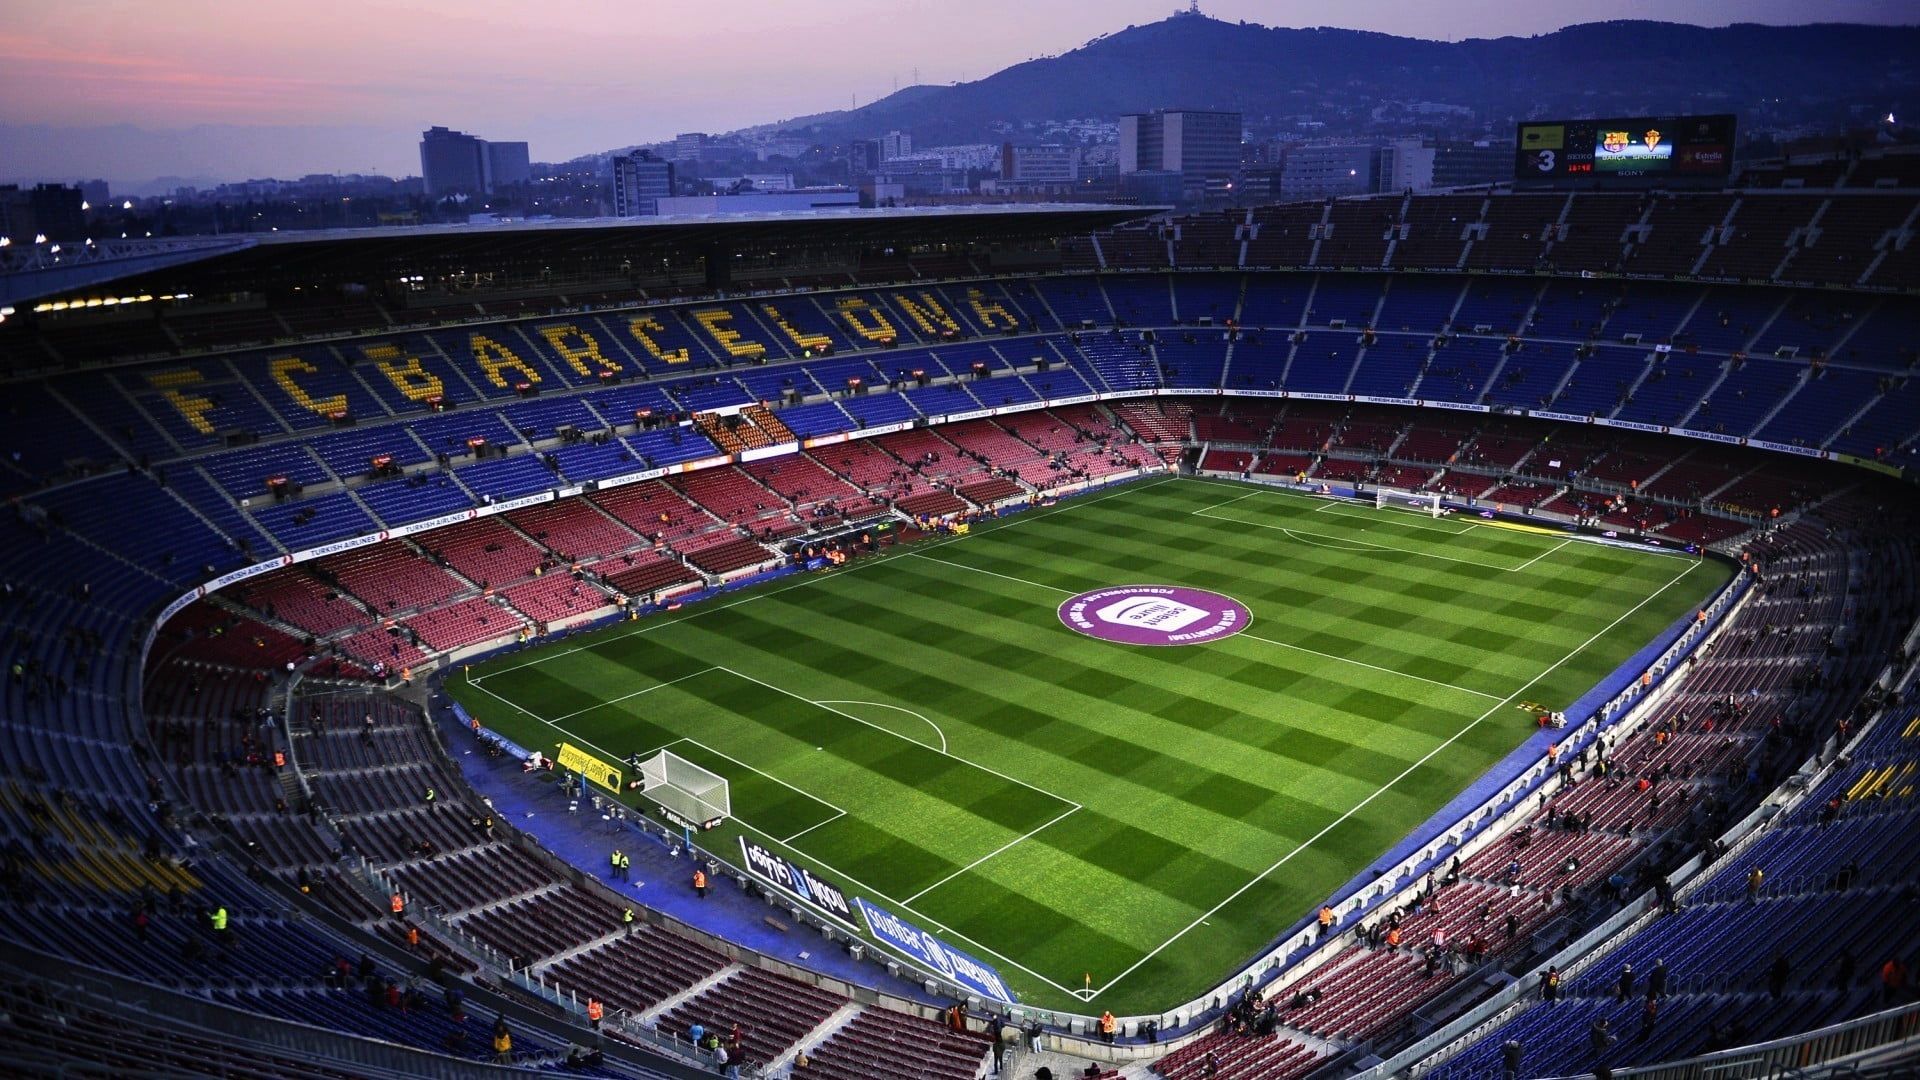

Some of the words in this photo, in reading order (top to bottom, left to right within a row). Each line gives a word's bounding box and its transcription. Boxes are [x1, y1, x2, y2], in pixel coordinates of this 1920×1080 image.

[1460, 403, 1484, 411] AIRLINES
[1559, 414, 1584, 422] AIRLINES
[1608, 419, 1632, 428] TURKISH
[1633, 423, 1659, 432] AIRLINES
[1684, 430, 1709, 438] TURKISH
[1710, 433, 1736, 442] AIRLINES
[1762, 442, 1788, 451] TURKISH
[1789, 446, 1817, 456] AIRLINES
[492, 501, 519, 512] TURKISH
[520, 494, 548, 505] AIRLINES
[405, 521, 435, 533] TURKISH
[436, 513, 465, 525] AIRLINES
[311, 545, 343, 557] TURKISH
[343, 535, 376, 549] AIRLINES
[1130, 604, 1170, 620] lliure
[1143, 606, 1187, 626] seient
[802, 869, 850, 913] mobily
[867, 907, 931, 962] Seguros
[943, 949, 1013, 1004] Allianz
